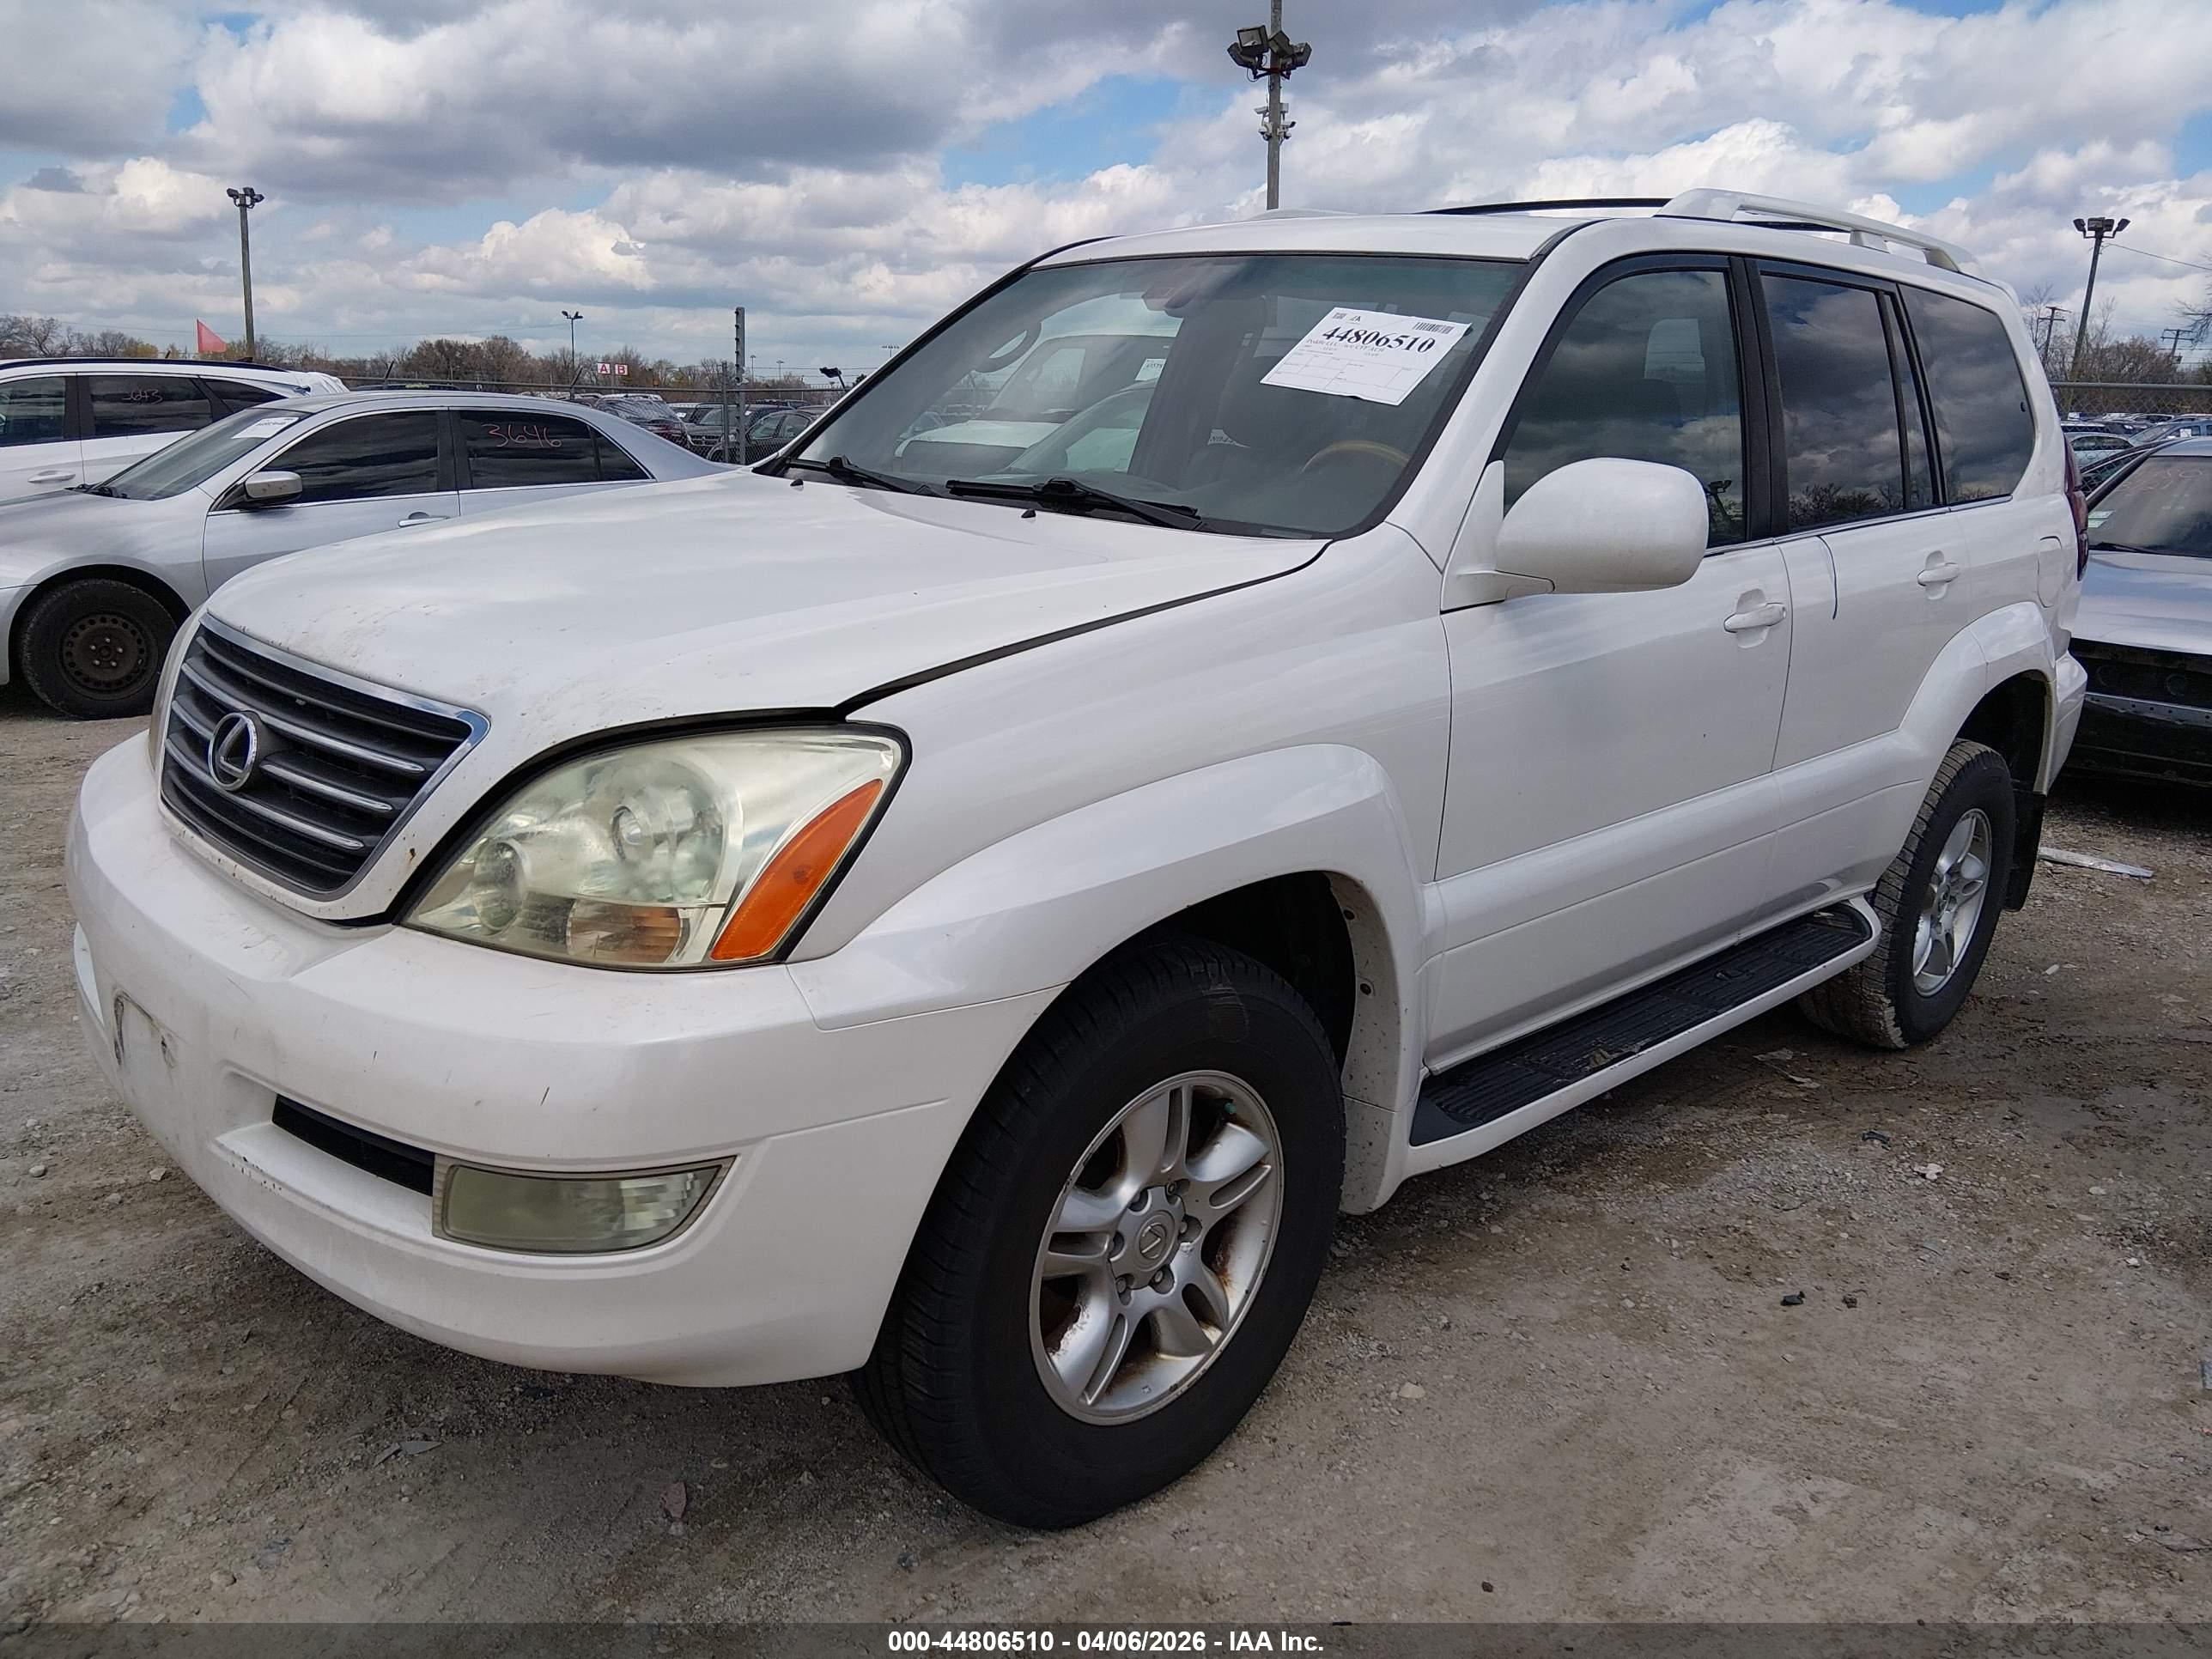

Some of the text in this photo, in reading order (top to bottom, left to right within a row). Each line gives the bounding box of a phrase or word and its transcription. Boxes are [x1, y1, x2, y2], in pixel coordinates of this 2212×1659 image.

[1322, 325, 1436, 353] 44806510
[600, 364, 609, 374] A
[617, 365, 626, 374] B
[481, 423, 563, 447] 3646
